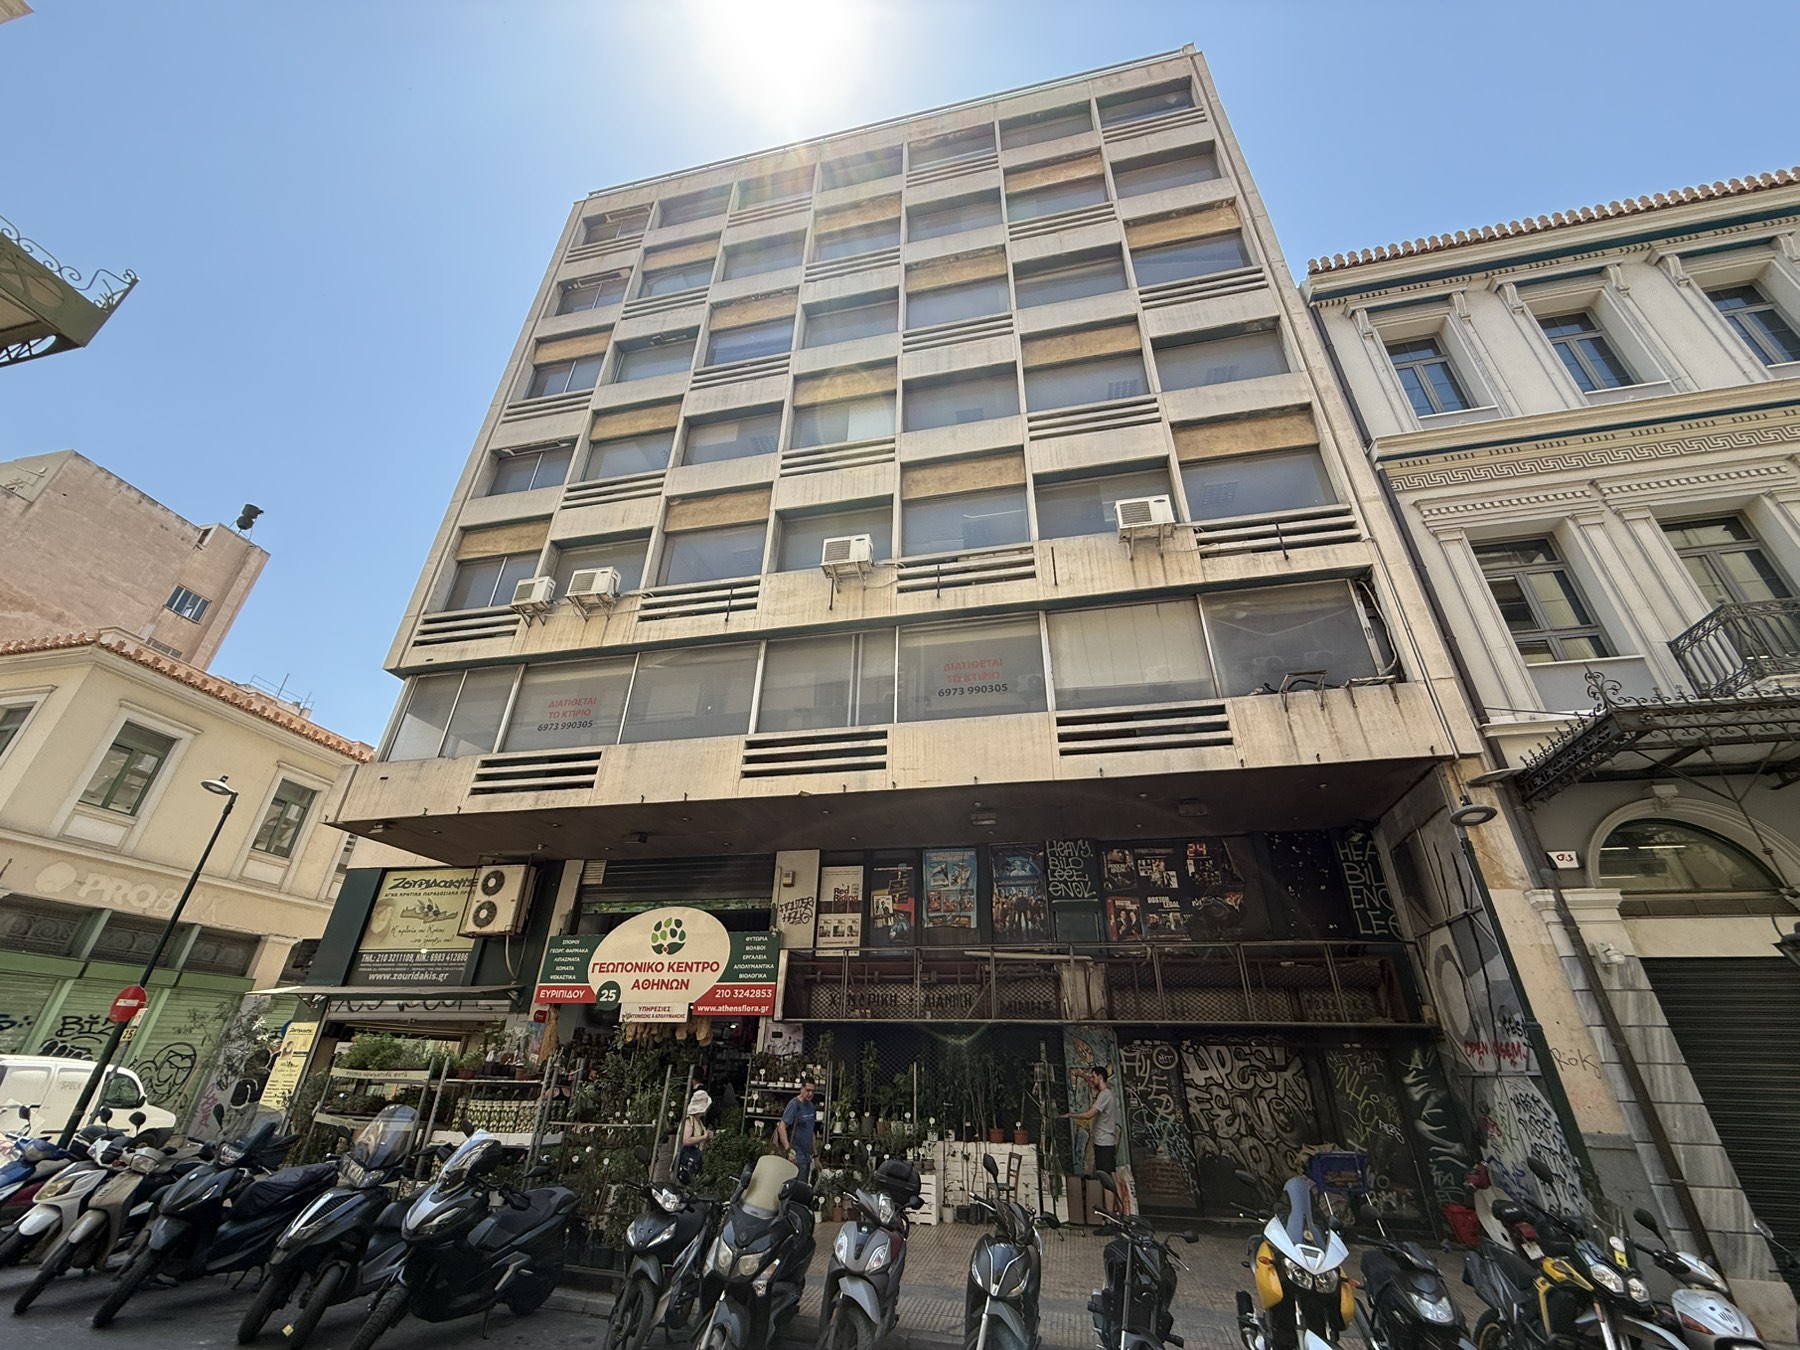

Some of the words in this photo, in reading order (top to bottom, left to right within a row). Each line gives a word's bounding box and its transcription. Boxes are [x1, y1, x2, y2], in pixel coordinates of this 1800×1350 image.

[943, 659, 1003, 672] ΔΙΑΤΙΘΕΤΑΙ
[947, 674, 962, 683] ΤΟ
[938, 687, 965, 697] 6973
[967, 683, 1008, 695] 990305
[548, 697, 596, 708] ΔΙΑΤΙΘΕΤΑΙ
[549, 710, 560, 719] ΤΟ
[561, 709, 591, 718] ΚΤΙΡΙΟ
[537, 722, 559, 732] 6973
[560, 720, 593, 730] 990305
[591, 962, 664, 974] ΓΕΩΠΟΝΙΚΟ
[667, 960, 720, 973] ΚΕΝΤΡΟ
[368, 971, 449, 983] www.zouridakis.gr
[630, 978, 690, 991] ΑΘΗΝΩΝ
[539, 988, 586, 999] ΕΥΡΙΠΙΔΟΥ
[599, 989, 617, 1001] 25
[715, 988, 731, 998] 210
[732, 988, 772, 998] 3242853
[697, 1004, 770, 1014] www.athensflora.gr
